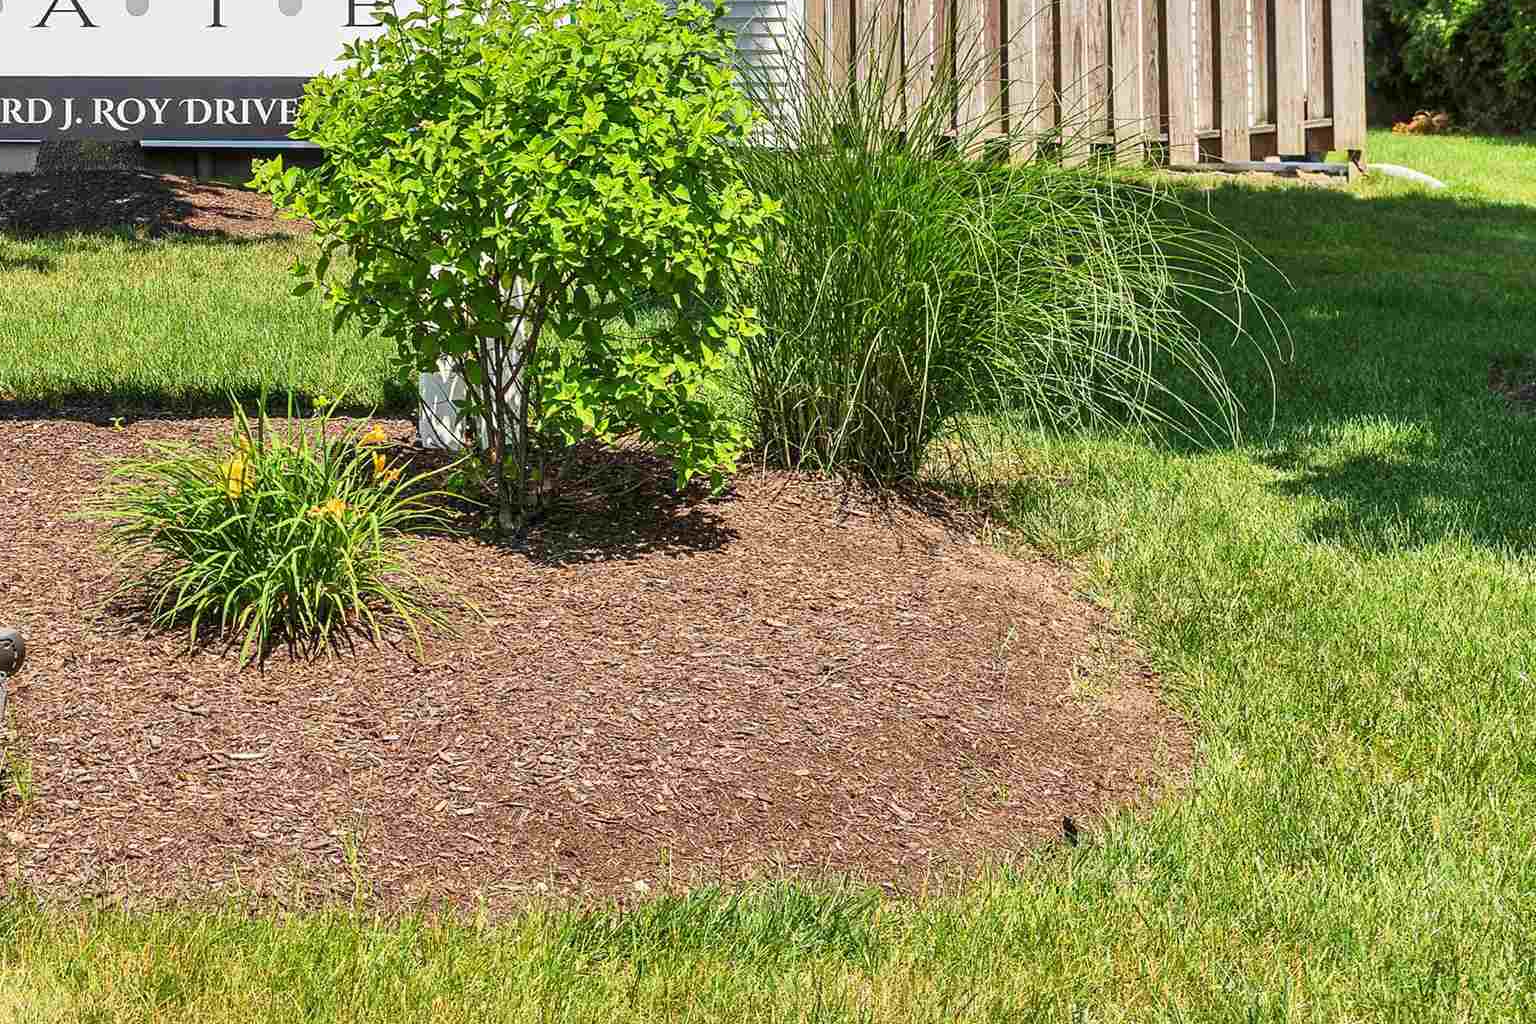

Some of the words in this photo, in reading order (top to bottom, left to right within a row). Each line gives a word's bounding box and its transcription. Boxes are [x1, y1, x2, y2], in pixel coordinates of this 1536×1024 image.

[58, 97, 83, 131] J.
[91, 97, 173, 132] ROY
[178, 97, 299, 126] DRIVE
